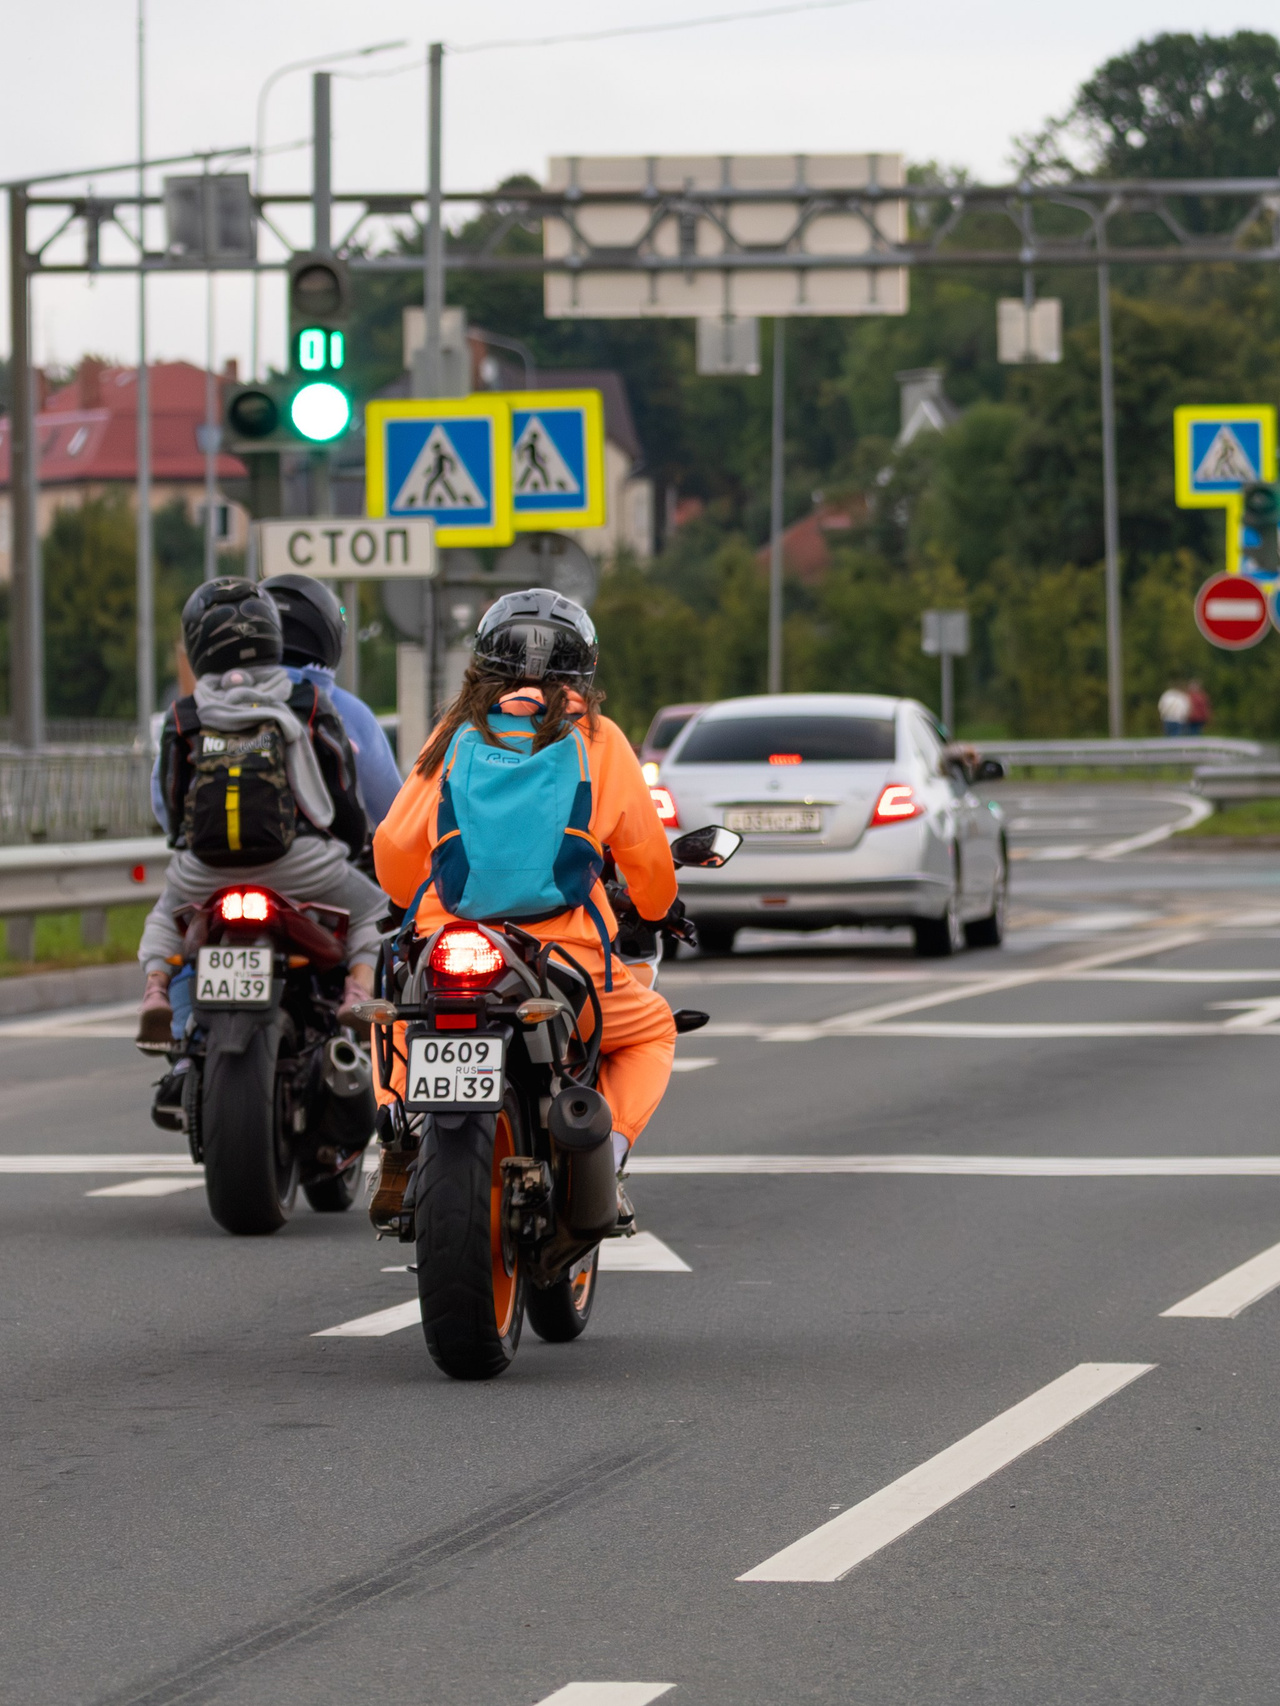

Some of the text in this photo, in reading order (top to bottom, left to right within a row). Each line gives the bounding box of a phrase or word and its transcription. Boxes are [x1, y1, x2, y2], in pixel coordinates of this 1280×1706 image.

[299, 328, 345, 371] 01
[287, 529, 410, 568] СТОП
[202, 735, 226, 754] NO
[209, 950, 261, 970] 8015
[239, 979, 265, 999] 39
[424, 1041, 490, 1064] 0609
[455, 1066, 477, 1075] RUS
[462, 1076, 495, 1099] 39
